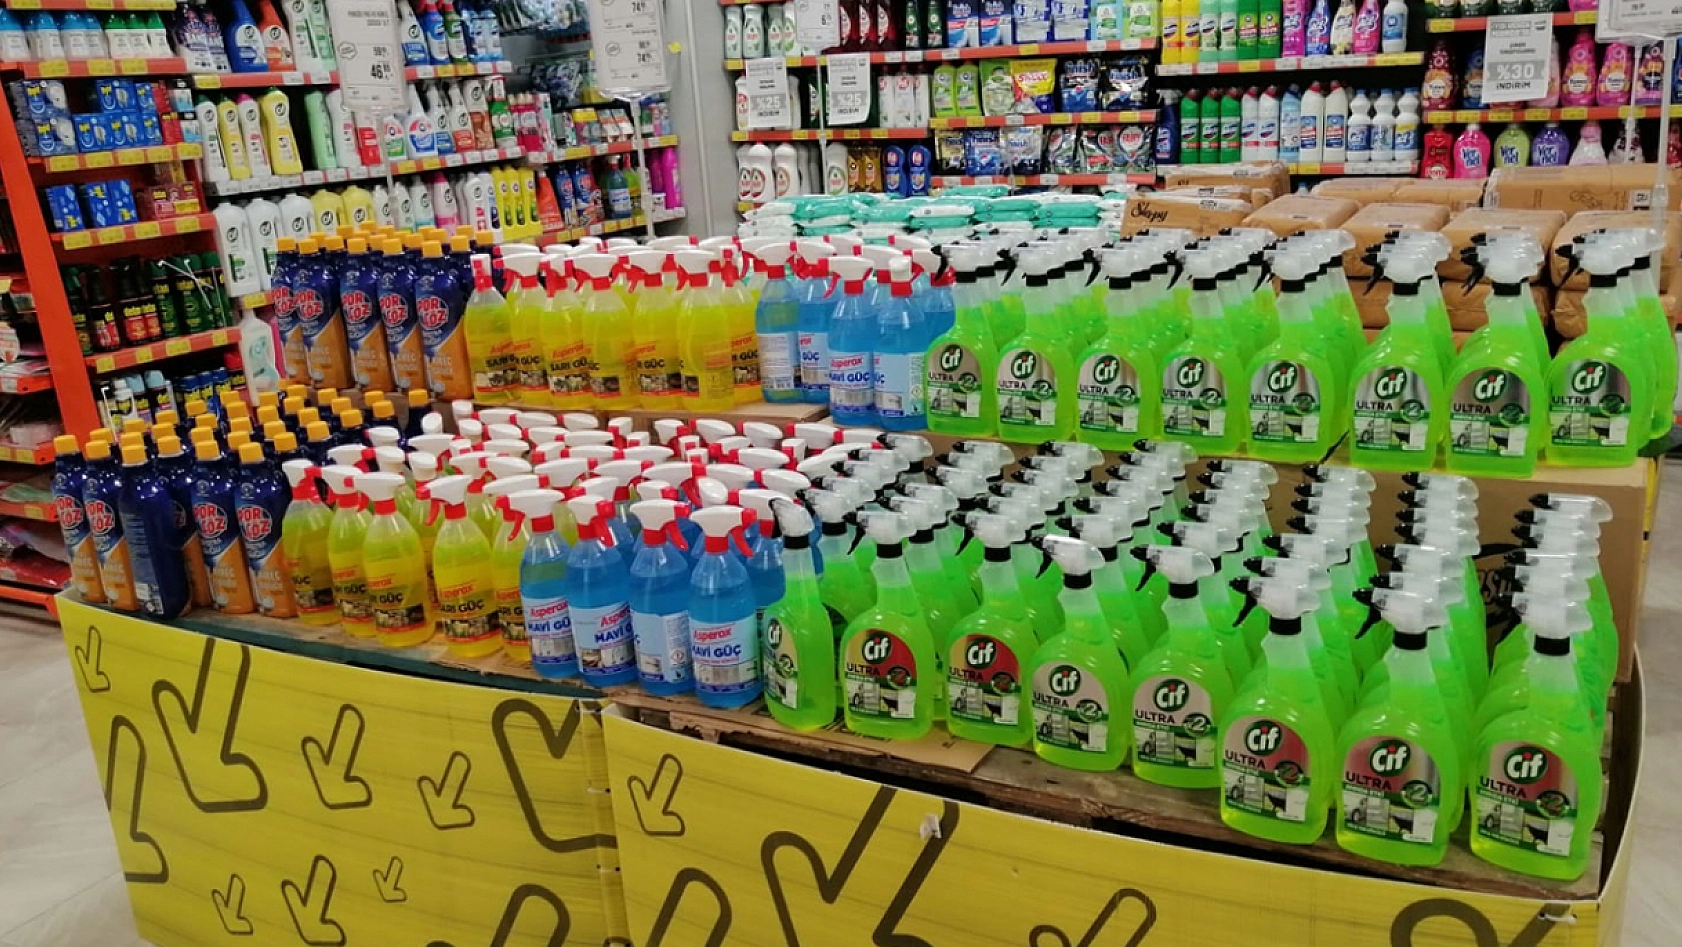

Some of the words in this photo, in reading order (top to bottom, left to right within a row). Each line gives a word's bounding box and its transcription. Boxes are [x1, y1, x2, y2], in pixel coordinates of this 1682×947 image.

[1496, 64, 1534, 80] %30
[941, 346, 961, 370] Cif
[1013, 354, 1034, 377] Cif
[1096, 358, 1118, 382] Cif
[1180, 361, 1203, 385] Cif
[1270, 366, 1295, 390] Cif
[1573, 365, 1604, 392] Cif
[1080, 384, 1109, 396] ULTRA
[1163, 388, 1194, 399] ULTRA
[1376, 372, 1405, 398] Cif
[1475, 373, 1505, 400] Cif
[1251, 394, 1286, 404] ULTRA
[1356, 400, 1393, 411] ULTRA
[1453, 402, 1492, 415] ULTRA
[1551, 395, 1592, 406] ULTRA
[768, 624, 781, 645] Cif
[713, 643, 742, 658] GÜÇ
[864, 637, 890, 661] Cif
[967, 641, 994, 666] Cif
[846, 662, 882, 677] ULTRA
[949, 666, 984, 681] ULTRA
[1051, 669, 1078, 694] Cif
[1033, 691, 1070, 708] ULTRA
[1156, 684, 1187, 709] Cif
[1135, 708, 1176, 725] ULTRA
[1246, 725, 1280, 752] Cif
[1224, 750, 1267, 770] ULTRA
[1371, 744, 1408, 773] Cif
[1506, 751, 1545, 779] Cif
[1346, 771, 1393, 792] ULTRA
[1480, 775, 1527, 799] ULTRA
